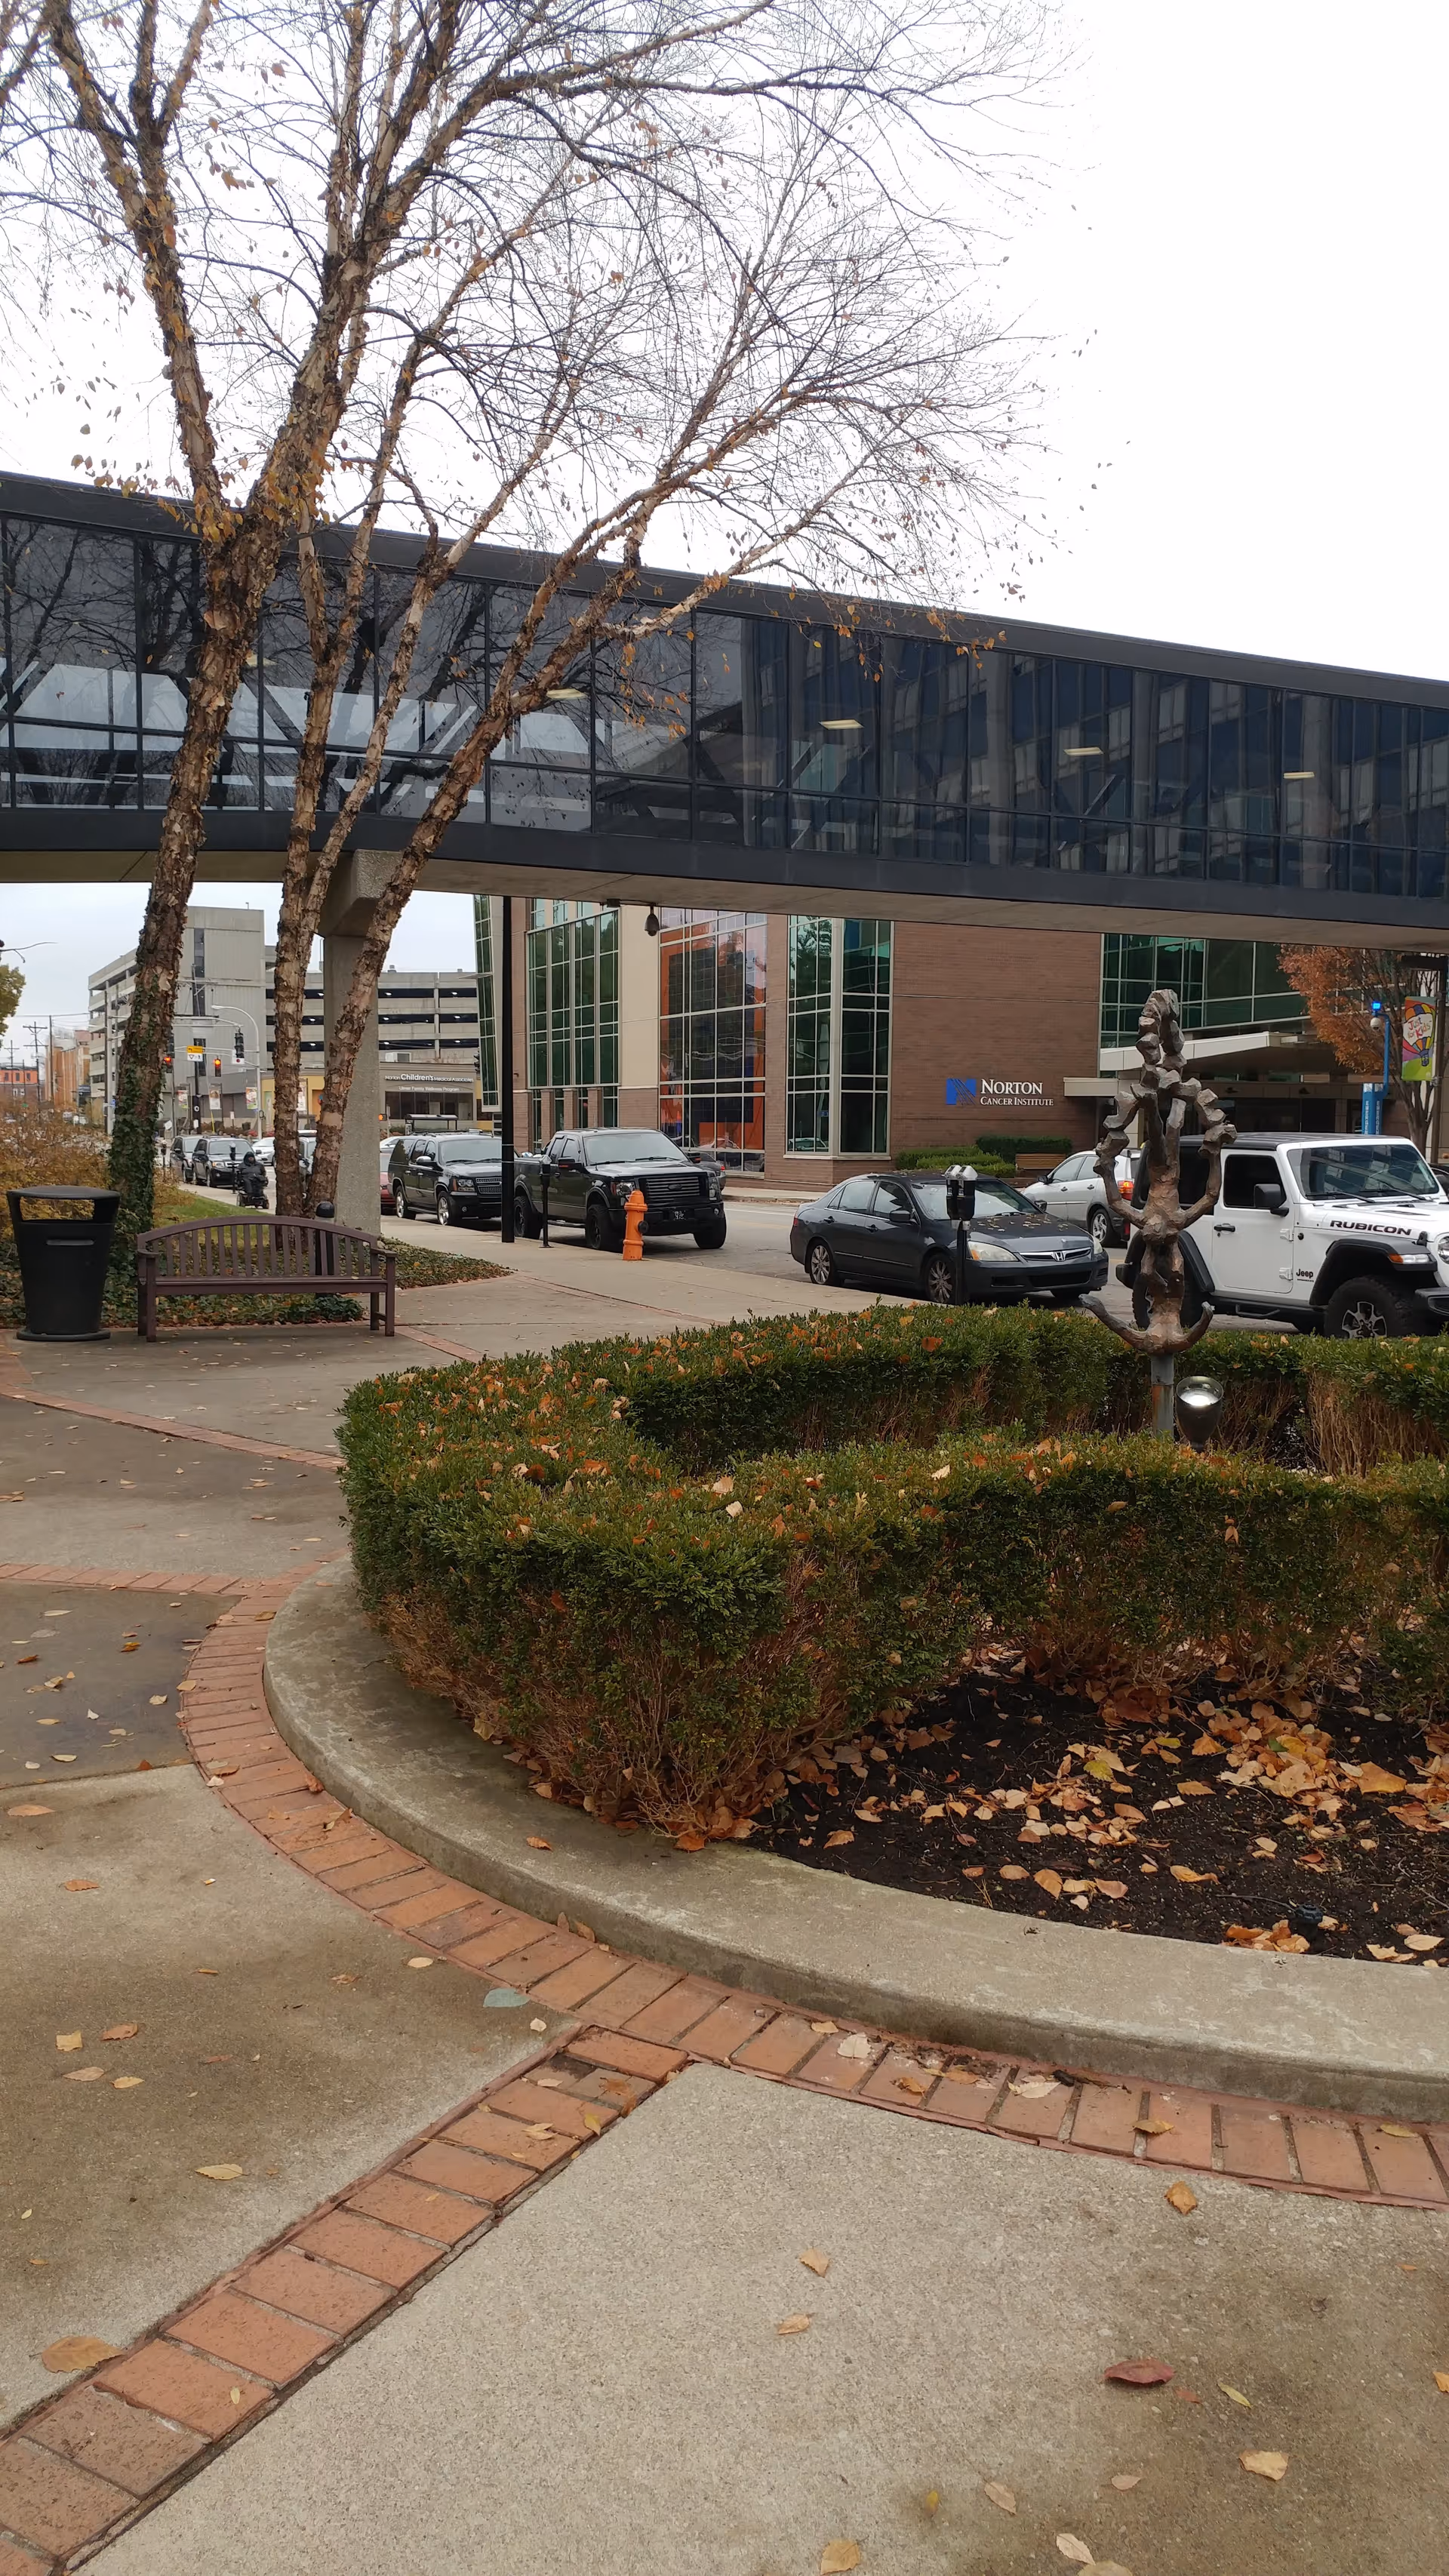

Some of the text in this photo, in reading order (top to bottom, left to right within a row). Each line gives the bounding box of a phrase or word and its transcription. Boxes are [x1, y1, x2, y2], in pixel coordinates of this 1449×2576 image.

[981, 1079, 1043, 1094] NORTON
[980, 1097, 1054, 1106] CANCER INSTITUTE
[1330, 1220, 1412, 1236] RUBICON
[1296, 1268, 1313, 1279] Jeep
